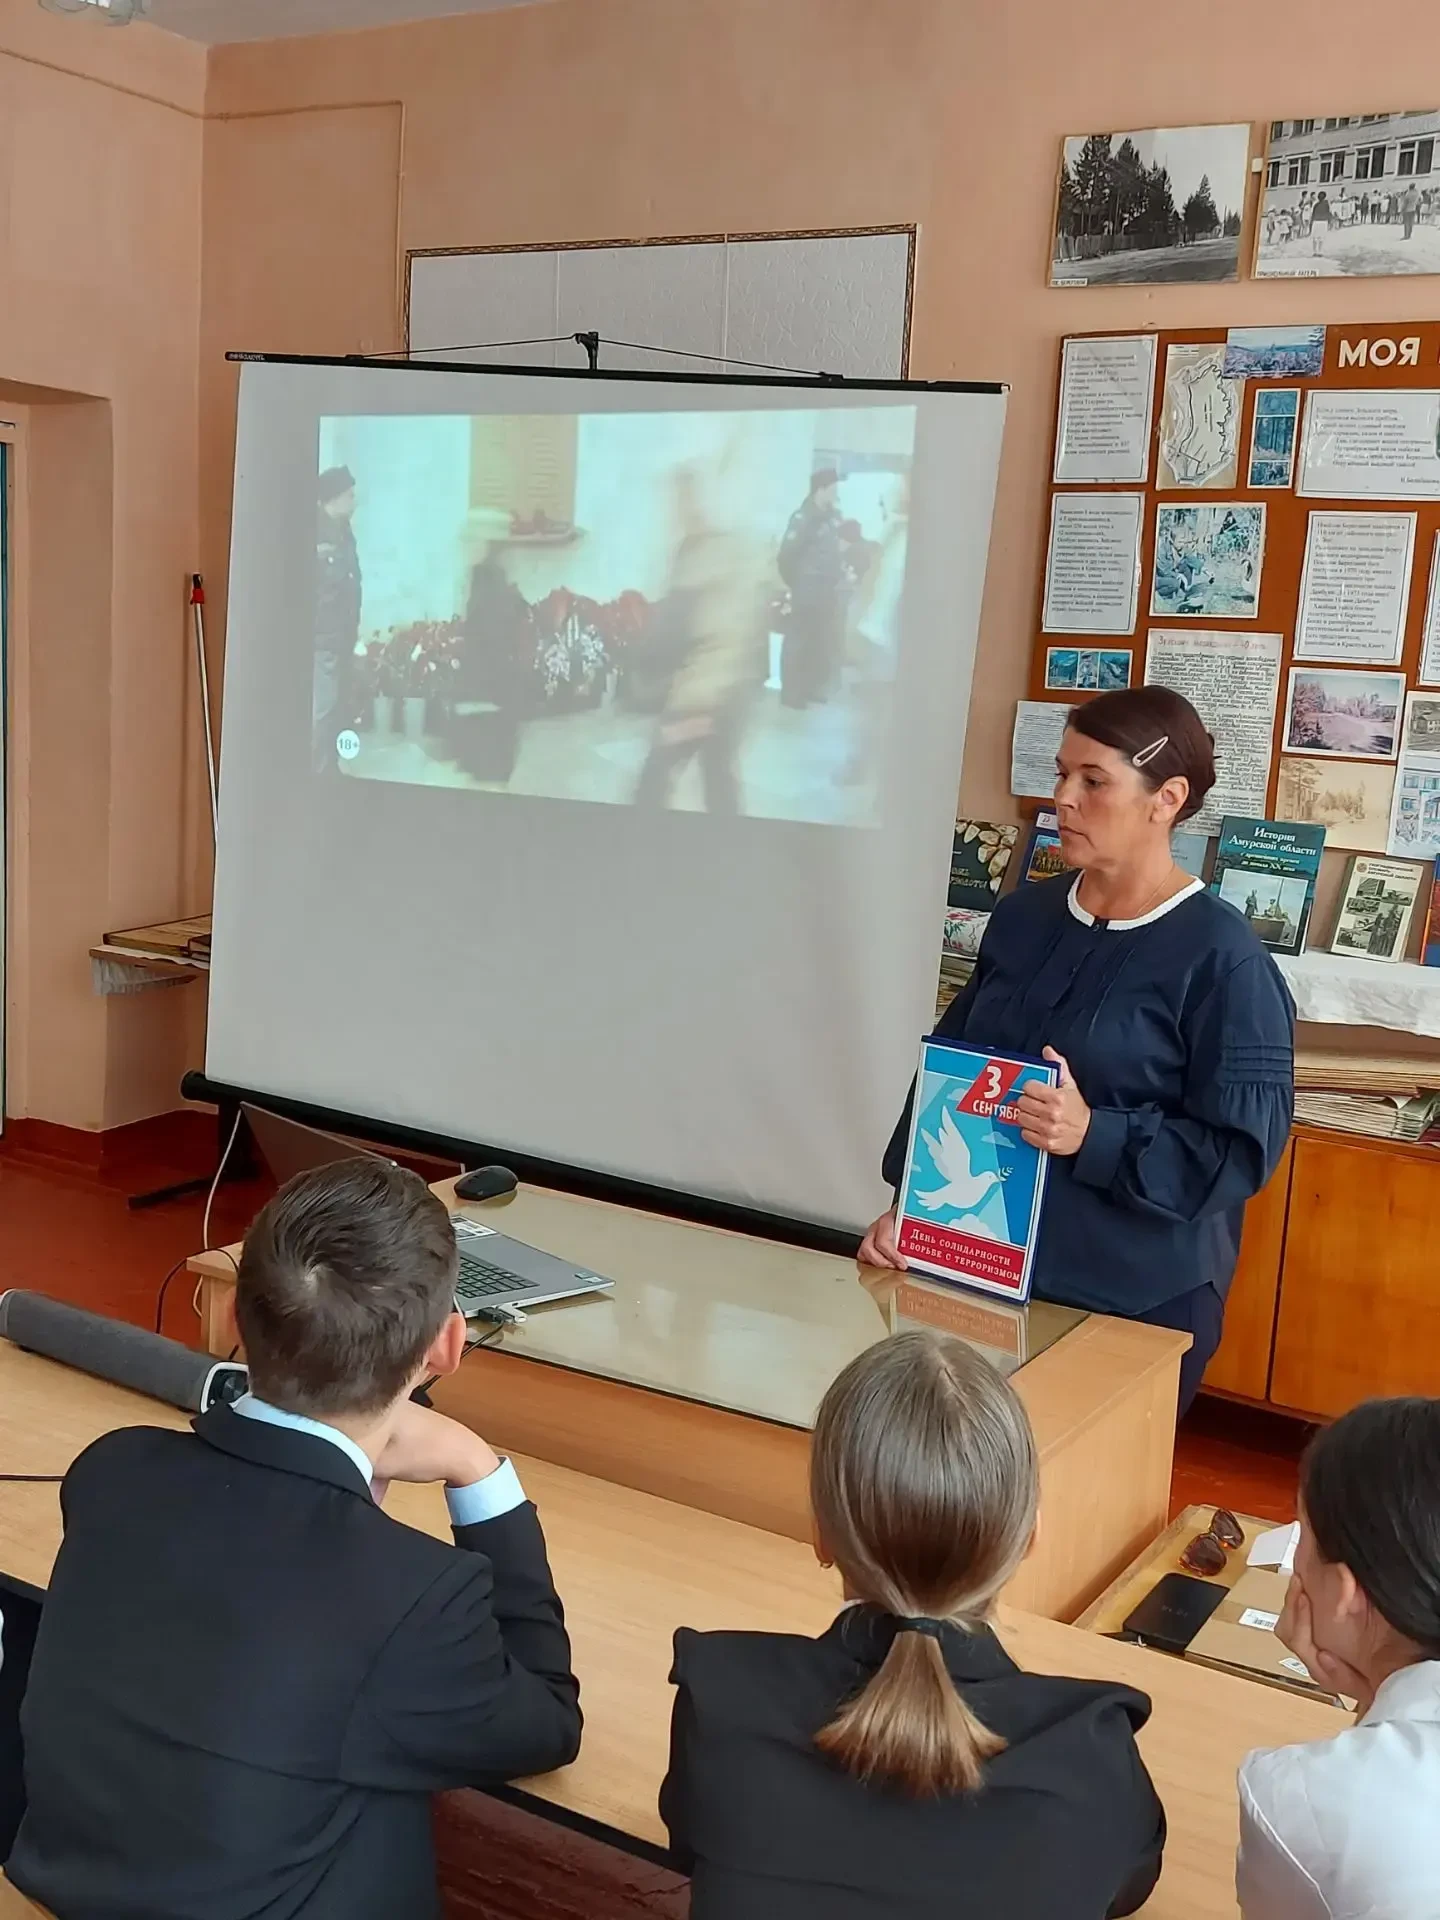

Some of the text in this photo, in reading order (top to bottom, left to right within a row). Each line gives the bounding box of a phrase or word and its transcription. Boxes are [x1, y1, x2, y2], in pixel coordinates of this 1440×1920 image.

[1338, 337, 1421, 368] МОЯ
[340, 738, 358, 750] 18+
[1228, 834, 1317, 856] Амурской области
[1254, 826, 1297, 842] История
[983, 1065, 1002, 1099] 3
[972, 1099, 1021, 1121] СЕНТЯБР
[910, 1242, 942, 1258] БОРЬБЕ
[954, 1255, 1020, 1282] ТЕРРОРИЗМОМ
[939, 1239, 1011, 1266] СОЛИДАРНОСТИ
